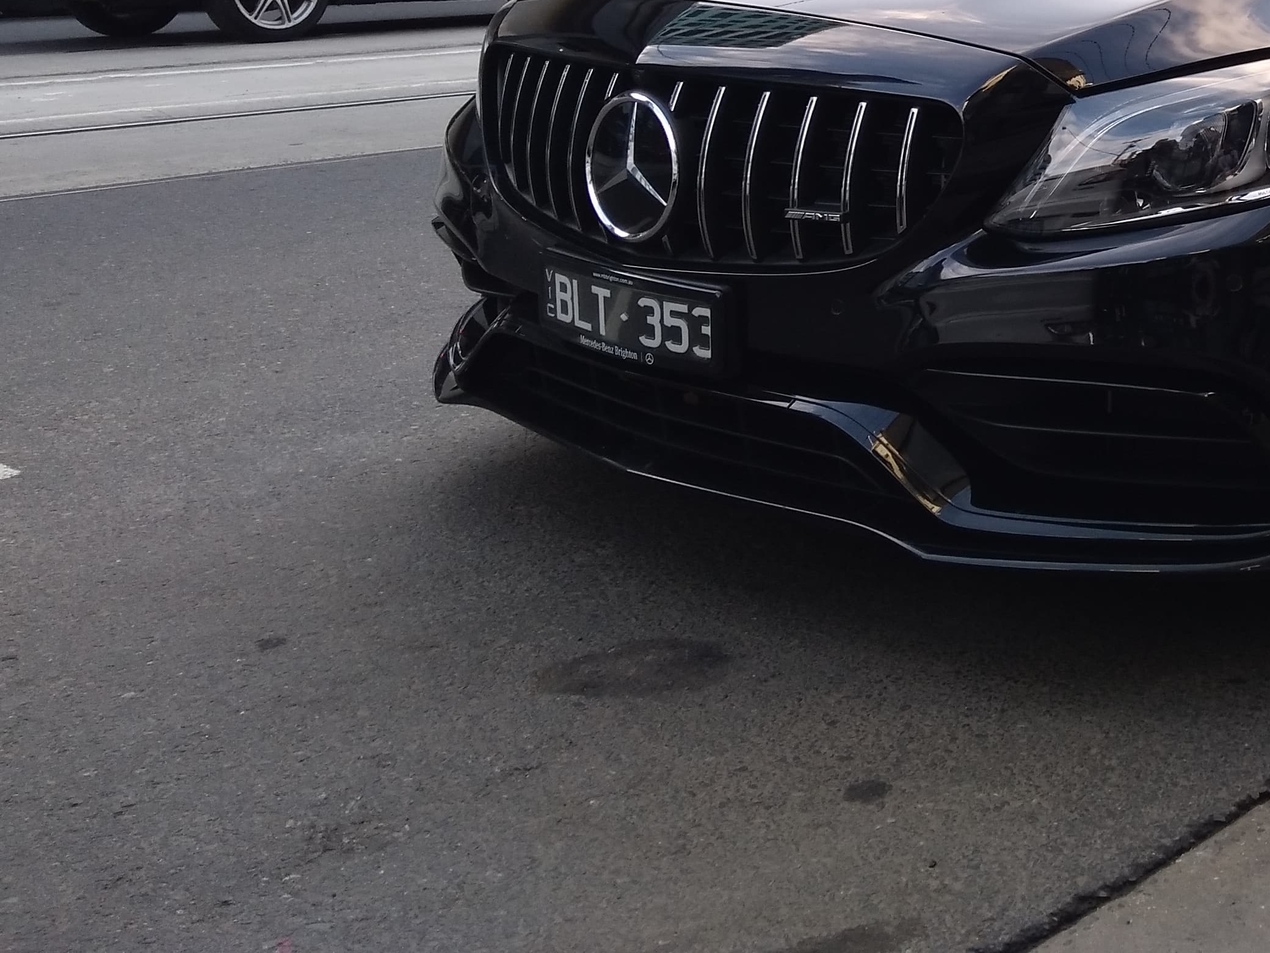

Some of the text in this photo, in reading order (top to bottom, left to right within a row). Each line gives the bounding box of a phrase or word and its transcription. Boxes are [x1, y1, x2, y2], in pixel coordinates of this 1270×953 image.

[802, 212, 841, 222] AMG
[555, 273, 712, 359] BLT 353
[579, 334, 638, 360] Mercedes-Benz Brighton
